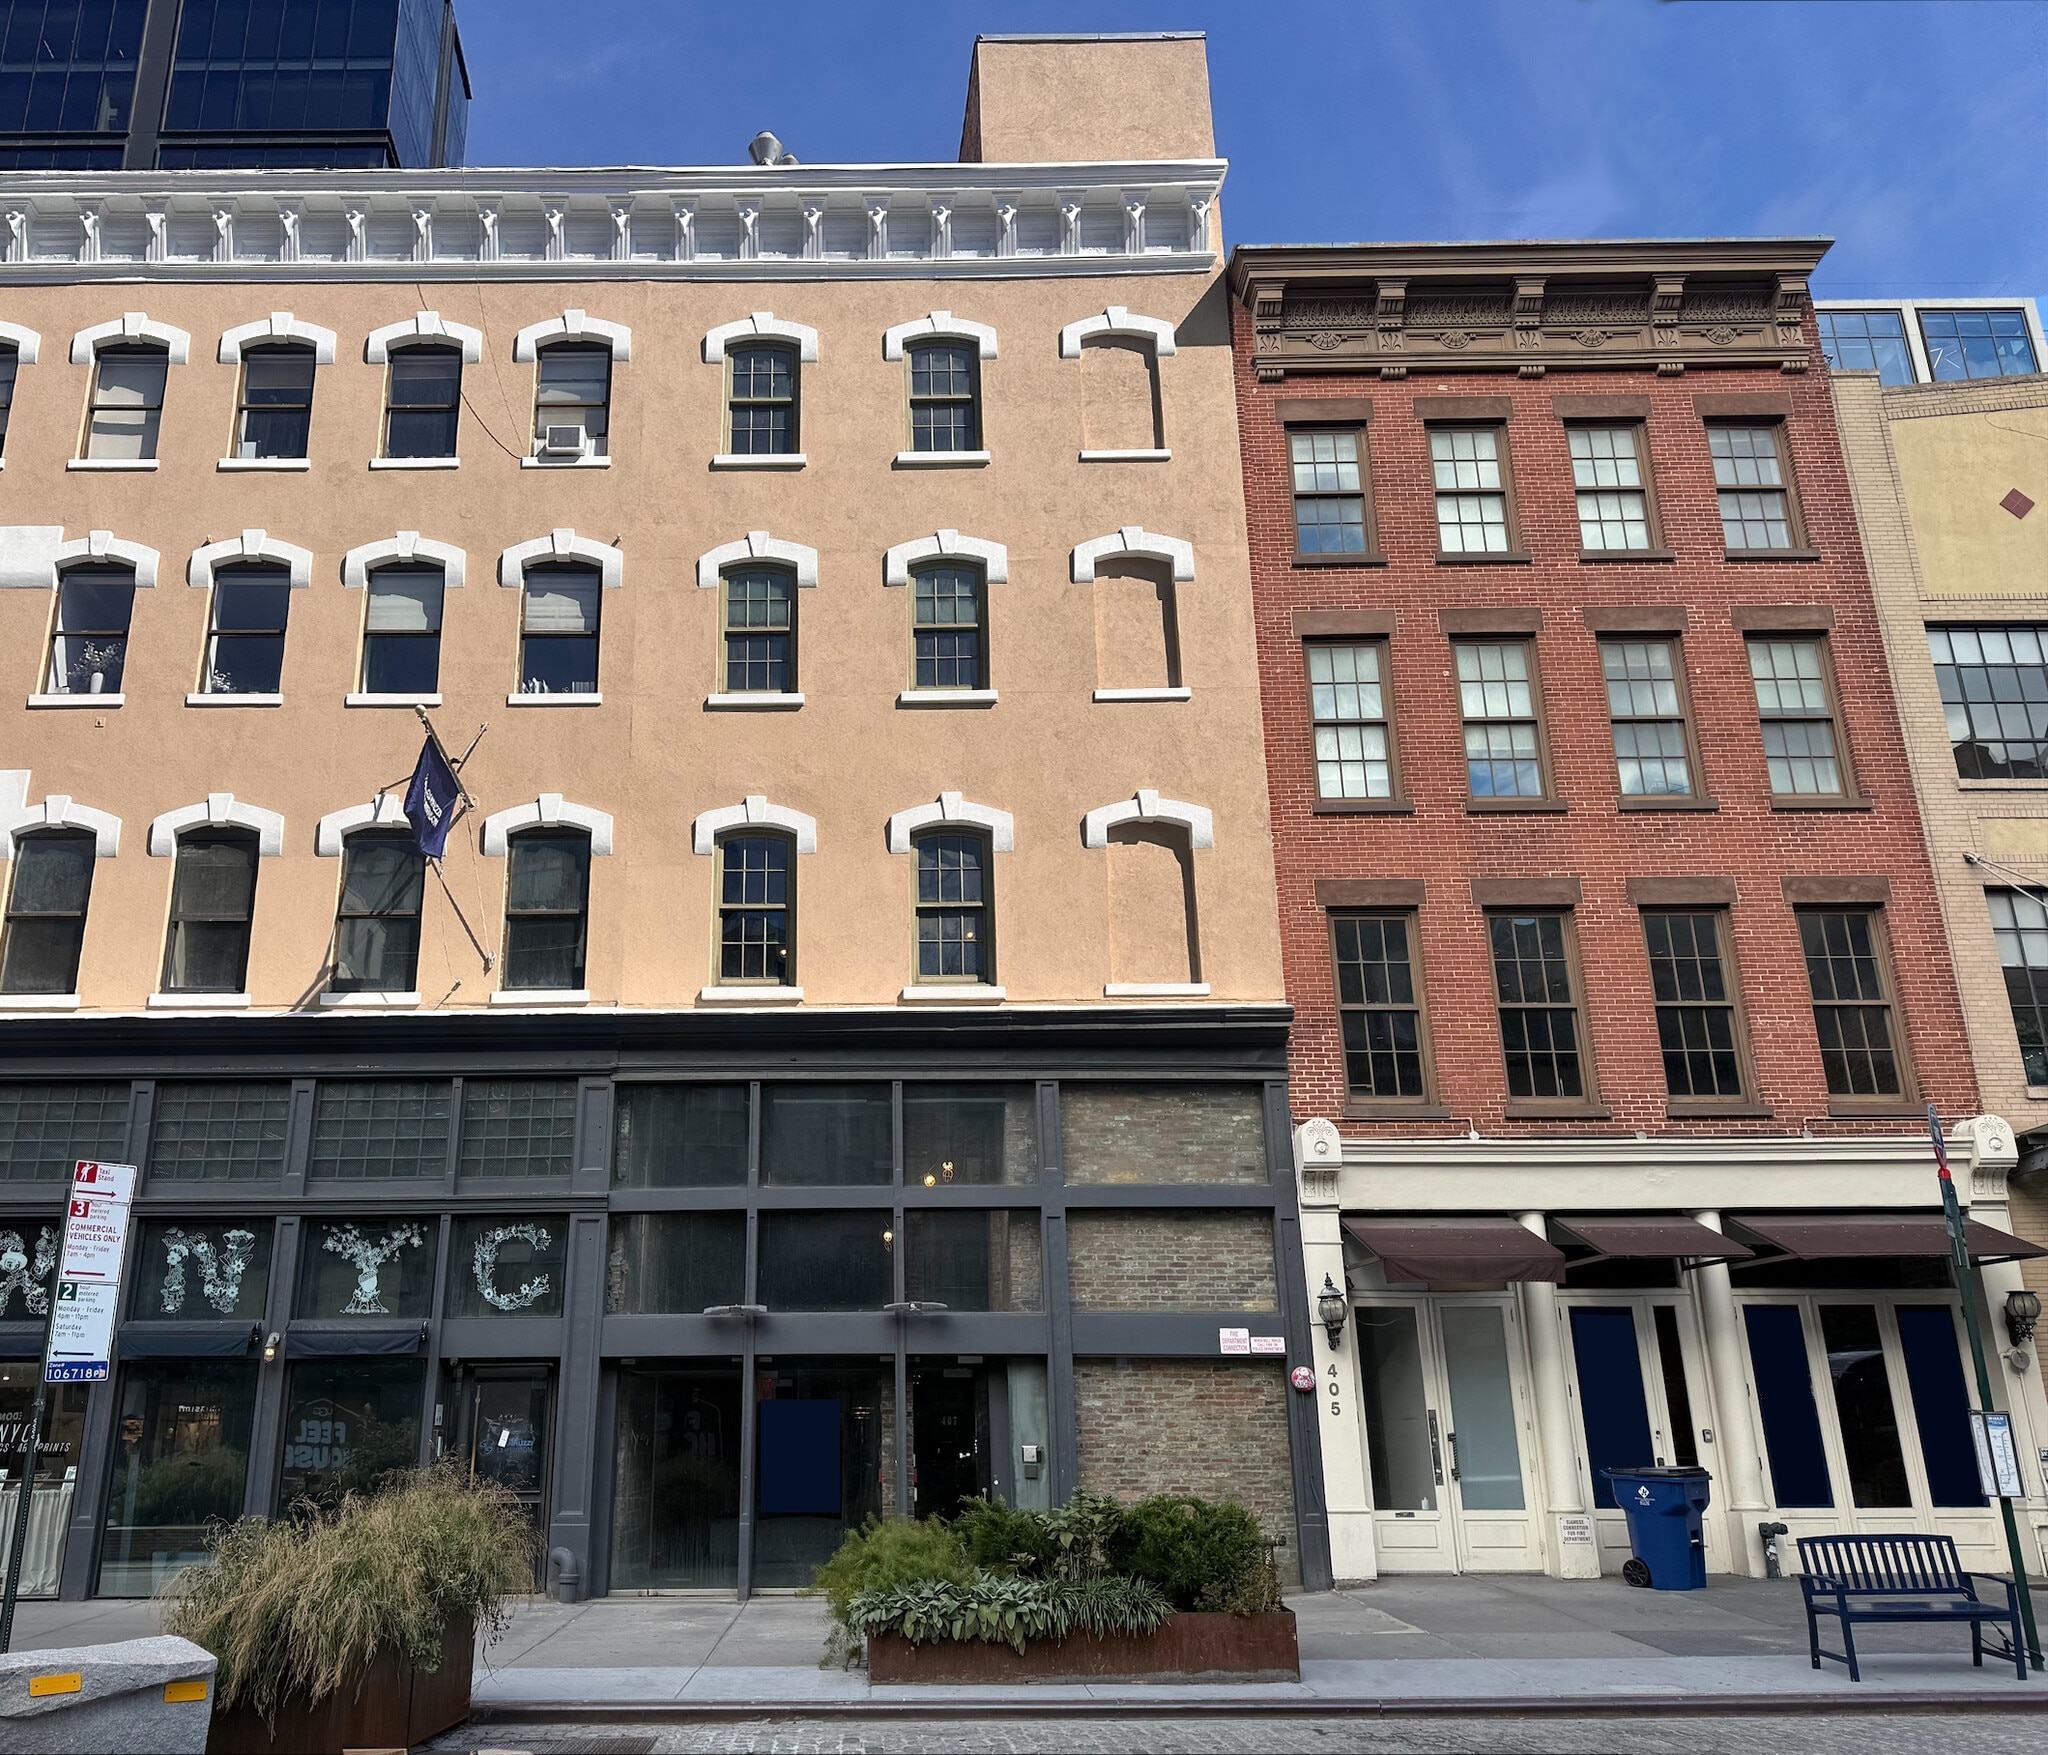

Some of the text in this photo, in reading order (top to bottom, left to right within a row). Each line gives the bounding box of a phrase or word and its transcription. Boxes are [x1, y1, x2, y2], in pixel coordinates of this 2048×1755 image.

[74, 1201, 84, 1216] 3
[70, 1223, 117, 1234] COMMERCIAL
[69, 1232, 121, 1243] VEHICLES ONLY
[67, 1243, 88, 1251] Monday
[93, 1245, 110, 1253] Friday
[62, 1283, 73, 1300] 2
[58, 1305, 81, 1313] Monday
[86, 1306, 104, 1314] Friday
[57, 1312, 70, 1320] 4pm
[75, 1313, 89, 1321] 11pm
[55, 1322, 82, 1331] Saturday
[71, 1331, 85, 1339] 11pm
[1221, 1337, 1248, 1345] DEPARTMENT
[1222, 1344, 1248, 1352] CONNECTION
[1327, 1363, 1341, 1416] 405
[941, 1415, 958, 1426] 407
[38, 1442, 72, 1453] PRINTS
